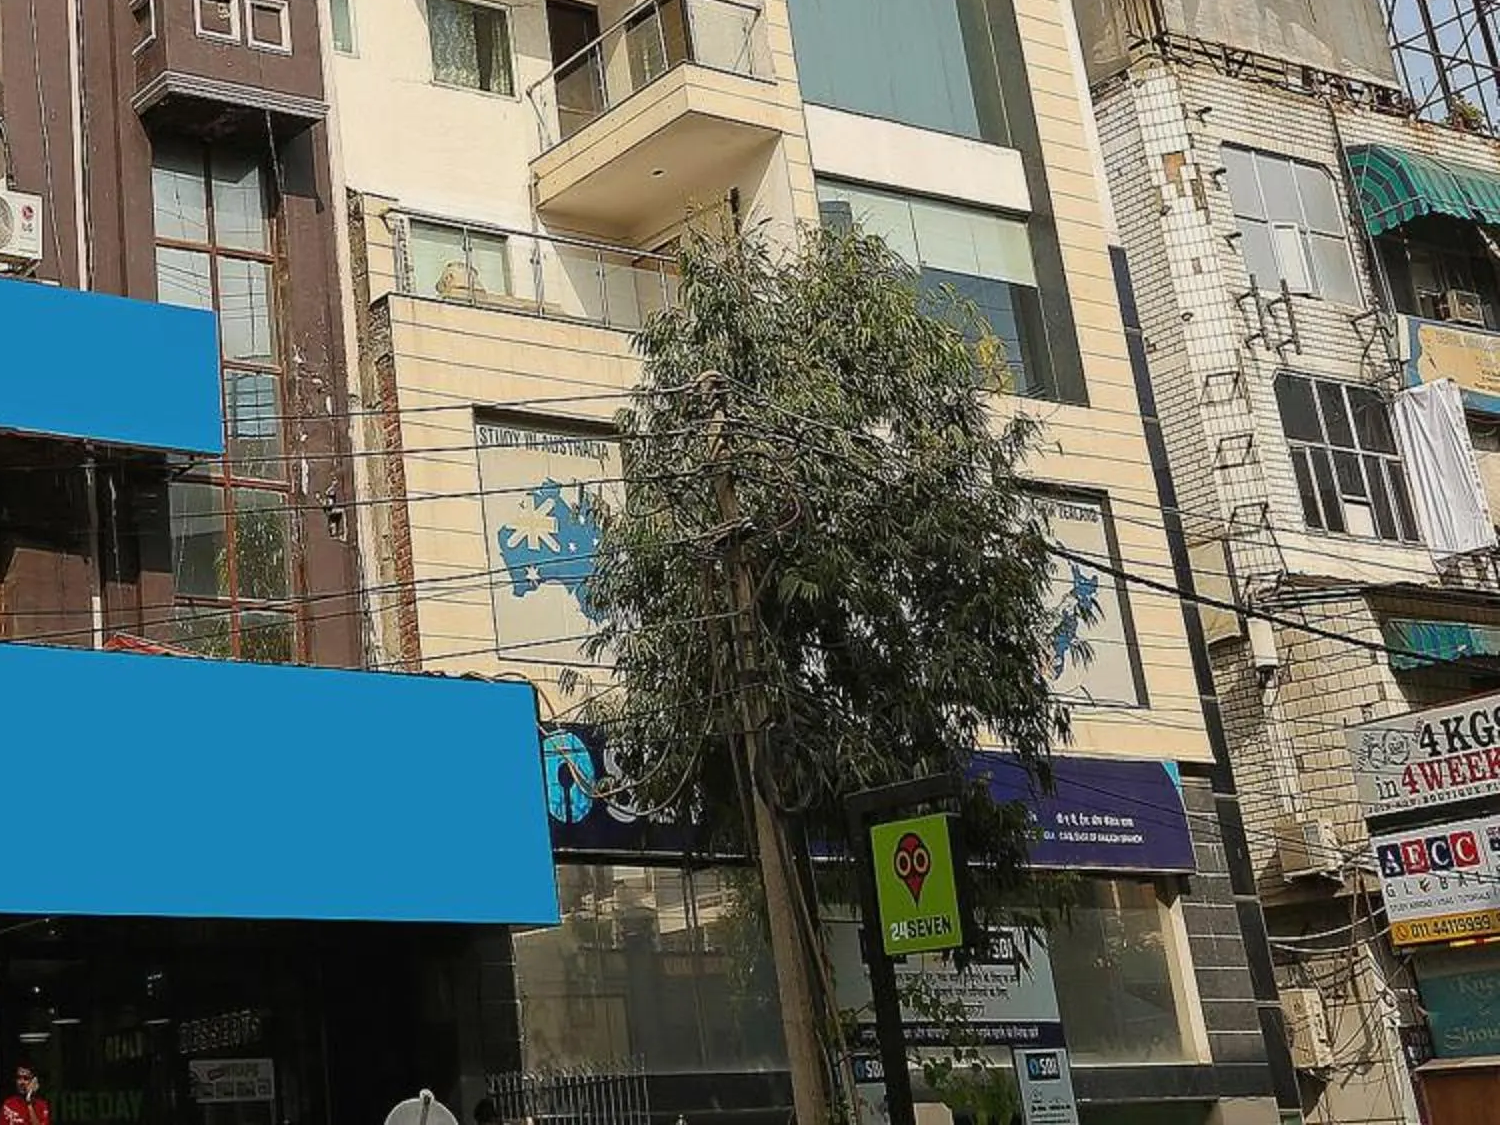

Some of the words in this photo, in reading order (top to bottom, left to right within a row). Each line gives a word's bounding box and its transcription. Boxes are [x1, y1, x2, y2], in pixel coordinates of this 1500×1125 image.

[479, 427, 521, 447] STUDY
[1376, 776, 1400, 800] in
[890, 915, 952, 942] 24SEVEN
